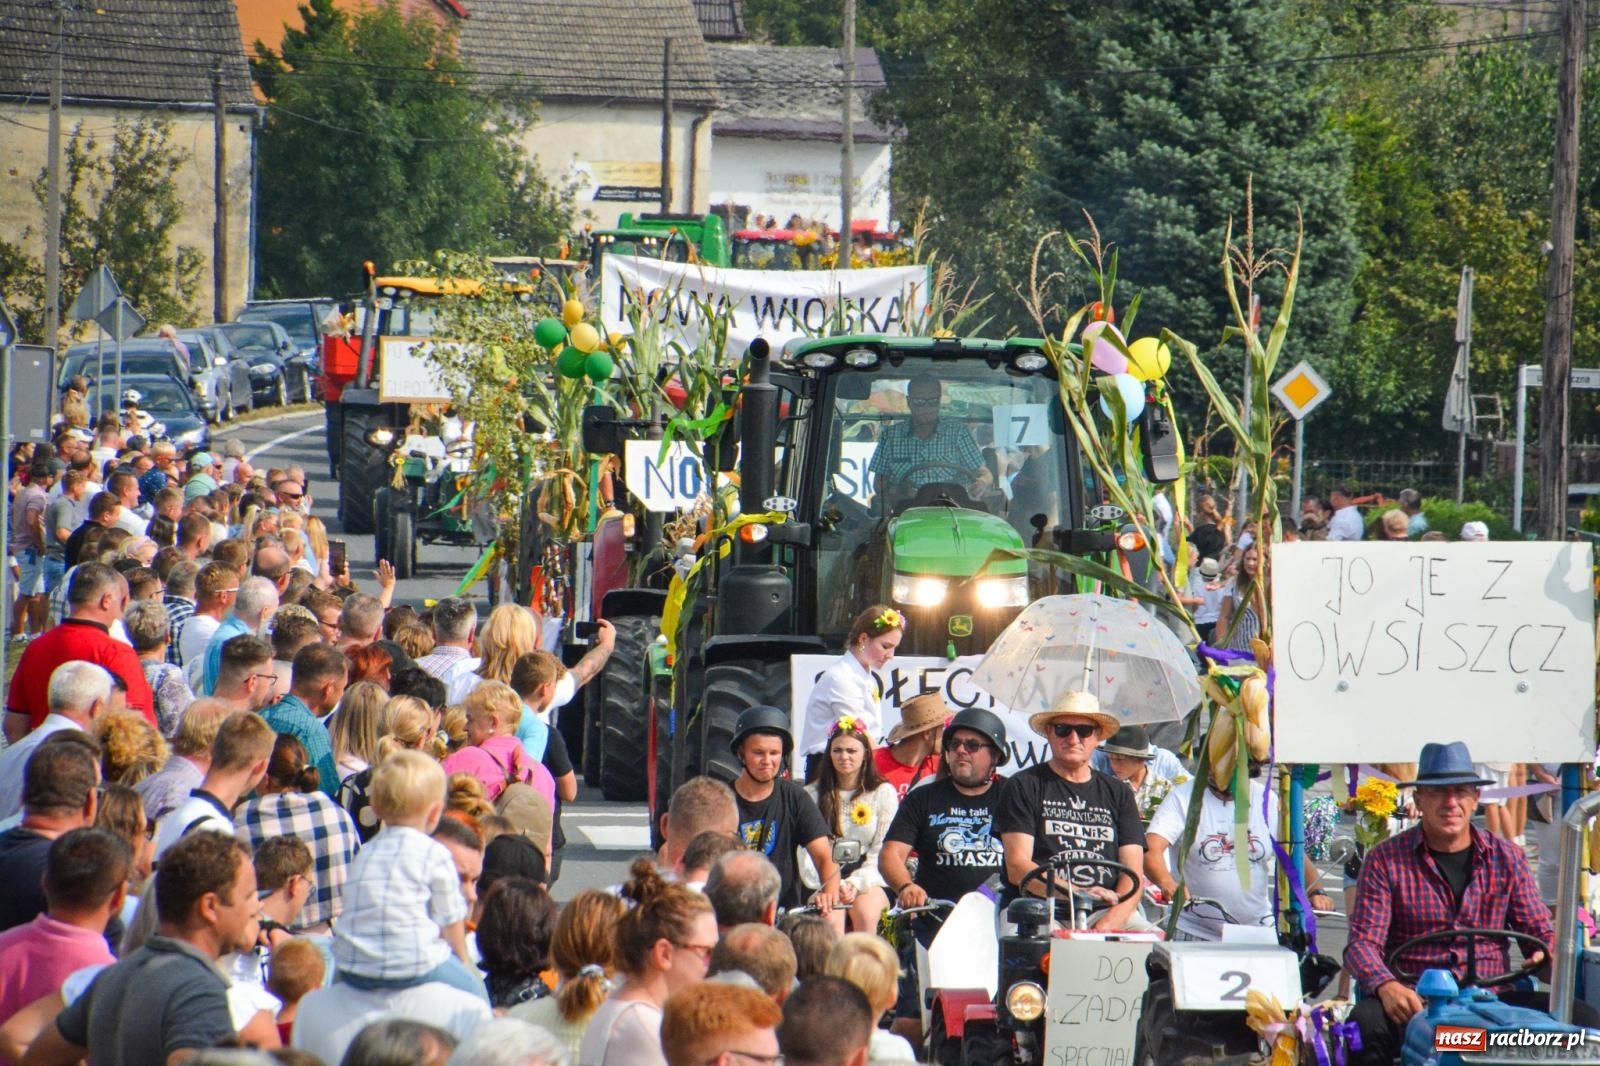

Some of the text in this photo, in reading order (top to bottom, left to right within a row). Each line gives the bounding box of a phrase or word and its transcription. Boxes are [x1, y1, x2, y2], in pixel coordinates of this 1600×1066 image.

[1011, 416, 1031, 444] 7
[1321, 555, 1514, 618] JO JE Z
[950, 807, 989, 818] Nie taki
[1092, 955, 1134, 985] DO
[1219, 969, 1252, 1001] 2
